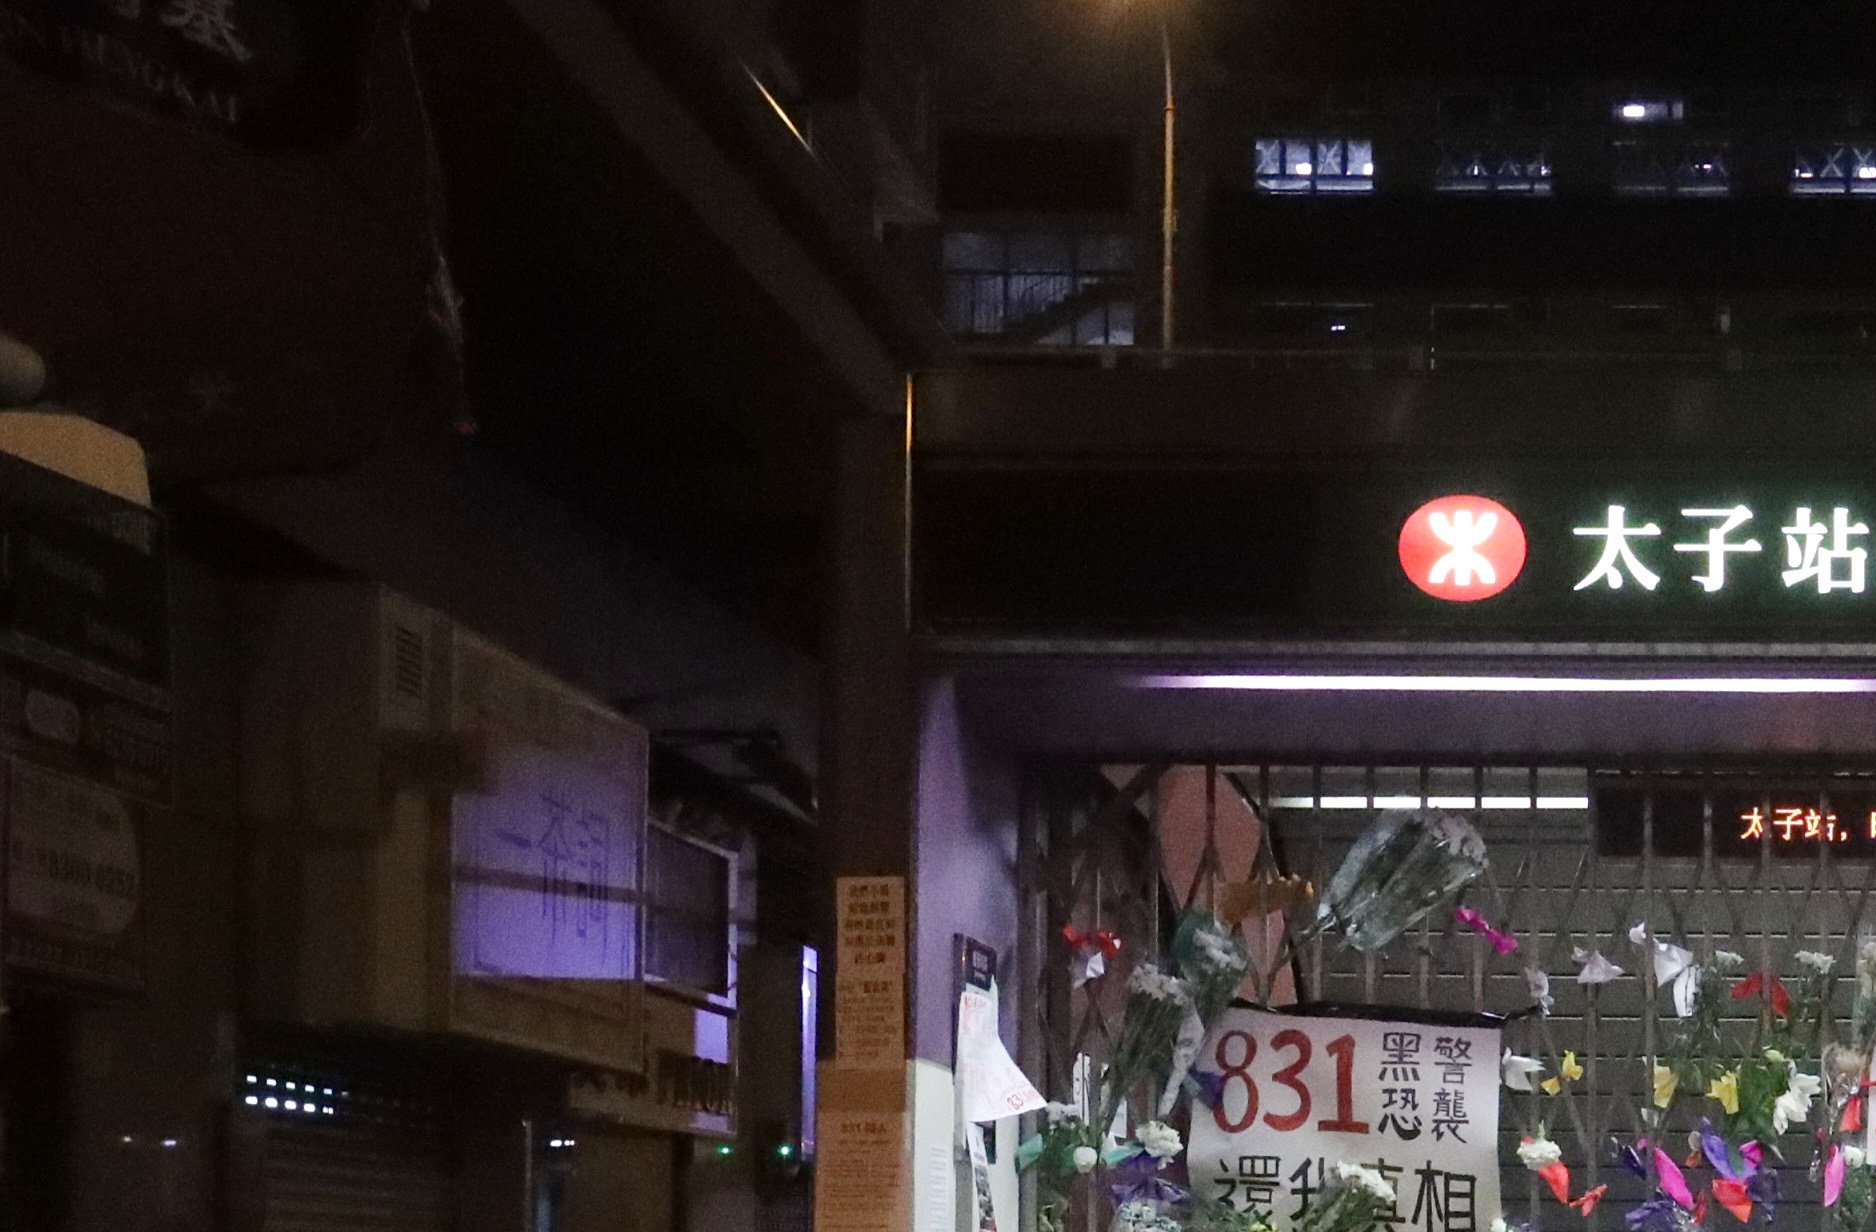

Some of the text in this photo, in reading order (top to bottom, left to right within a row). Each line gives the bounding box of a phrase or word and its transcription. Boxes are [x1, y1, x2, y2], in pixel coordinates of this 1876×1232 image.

[1573, 505, 1870, 594] 太子站
[1213, 1028, 1370, 1134] 831
